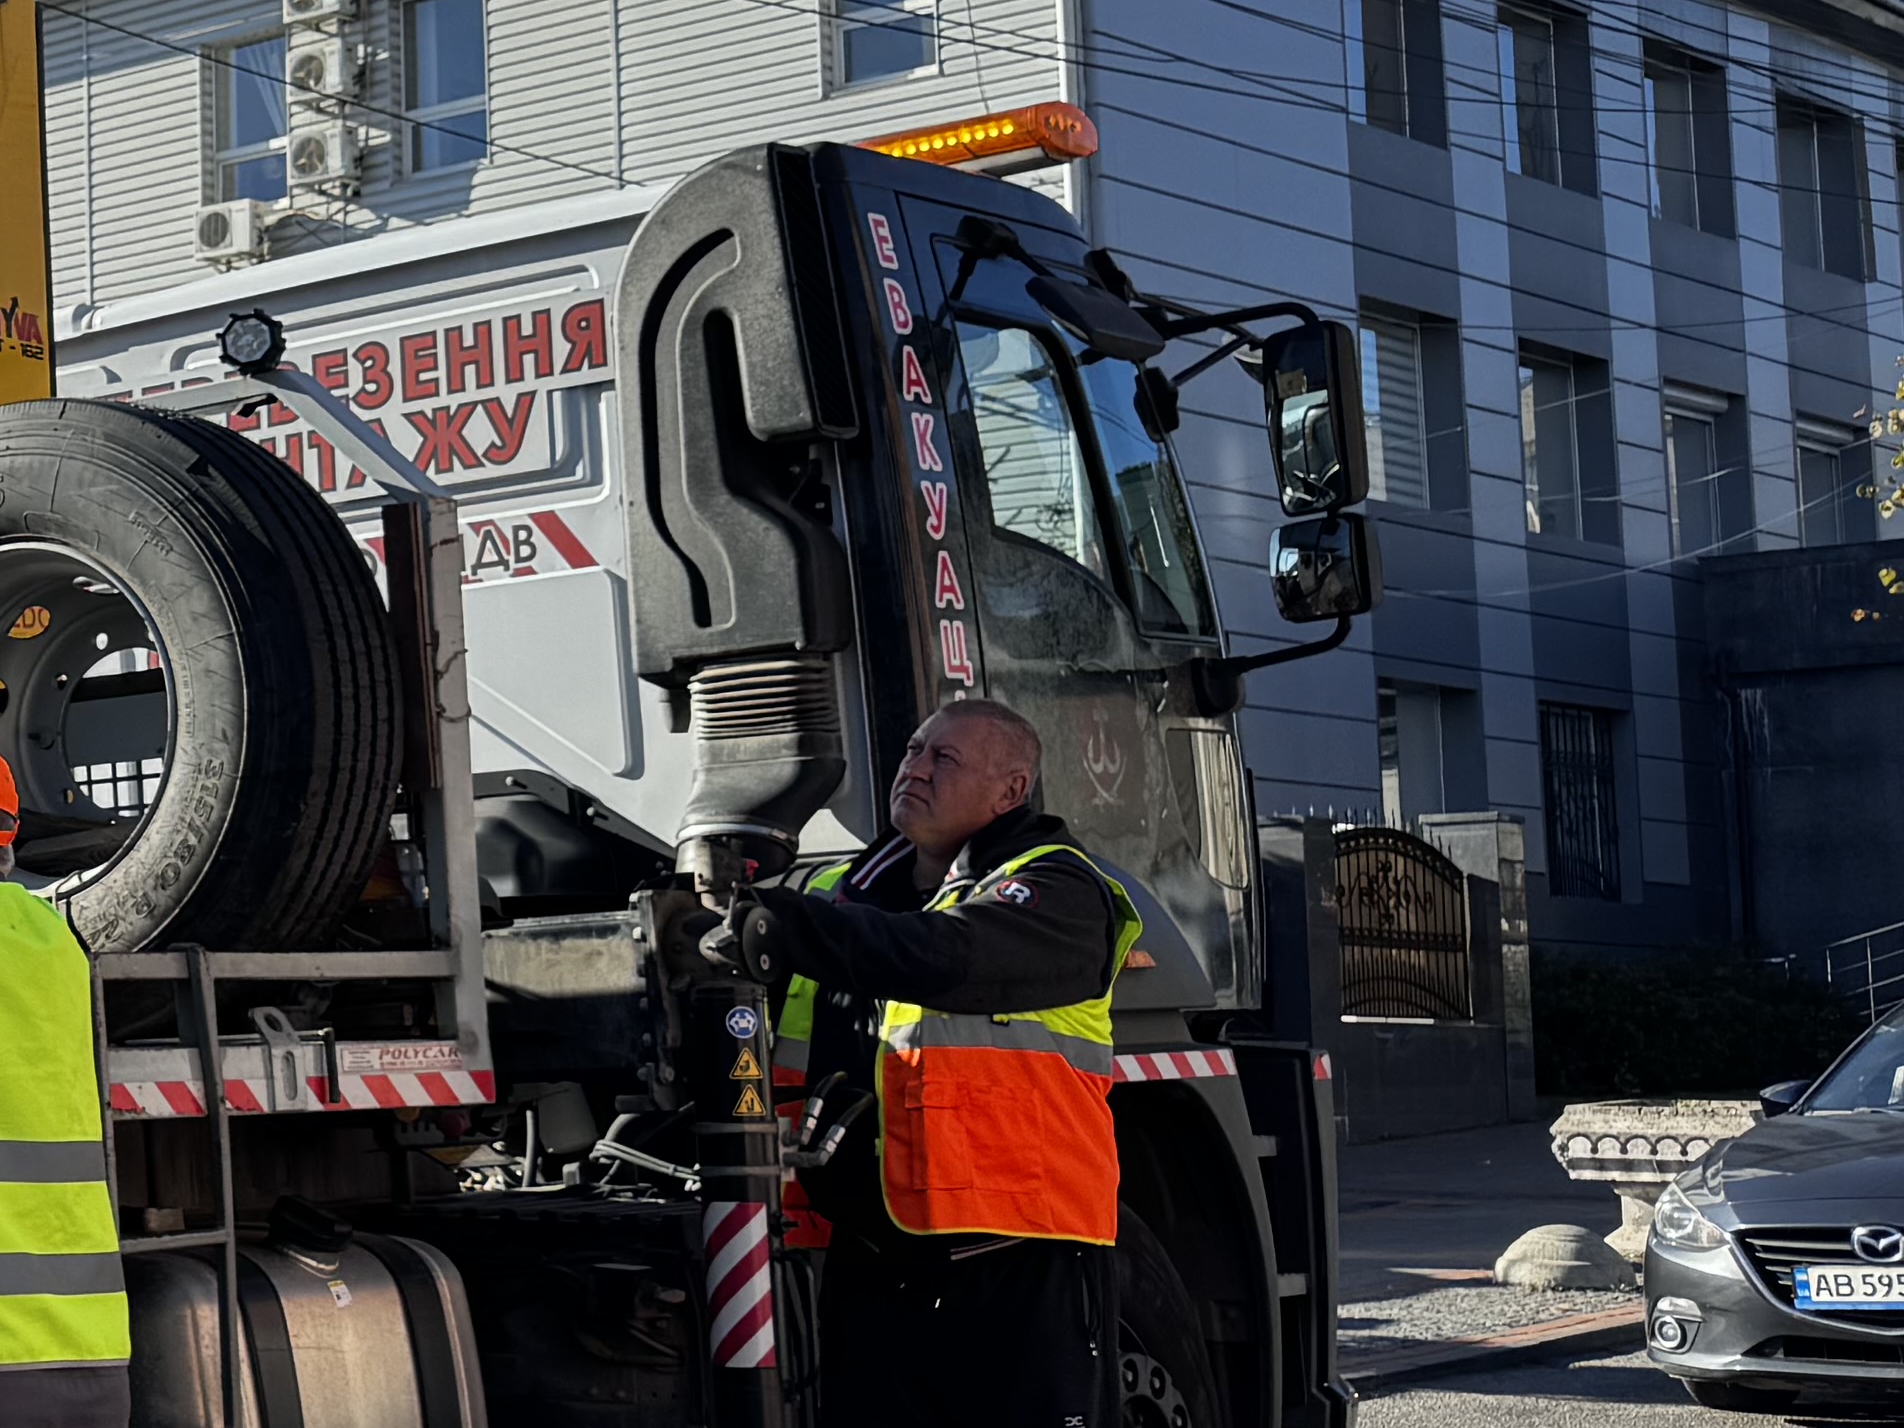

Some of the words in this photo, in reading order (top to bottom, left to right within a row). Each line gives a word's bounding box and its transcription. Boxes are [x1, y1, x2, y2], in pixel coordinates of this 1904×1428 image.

[867, 212, 974, 701] ЕВАКУАЦ
[459, 524, 537, 576] ДВ
[379, 1046, 459, 1061] POLYCAR
[1815, 1274, 1855, 1298] AB
